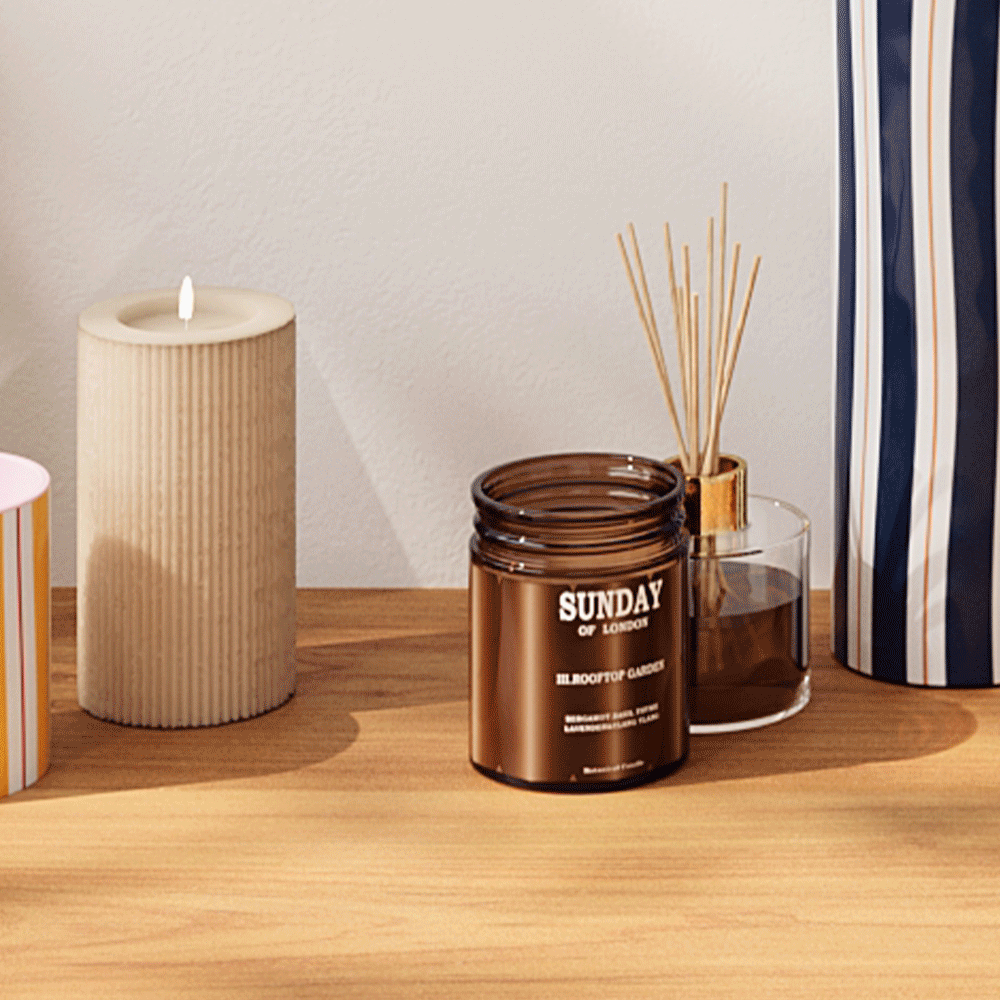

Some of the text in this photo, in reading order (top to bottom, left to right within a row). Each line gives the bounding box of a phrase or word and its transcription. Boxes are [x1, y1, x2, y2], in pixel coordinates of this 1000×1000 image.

[559, 579, 663, 621] SUNDAY
[578, 616, 649, 637] OF LONDON
[627, 659, 665, 680] GARDEN
